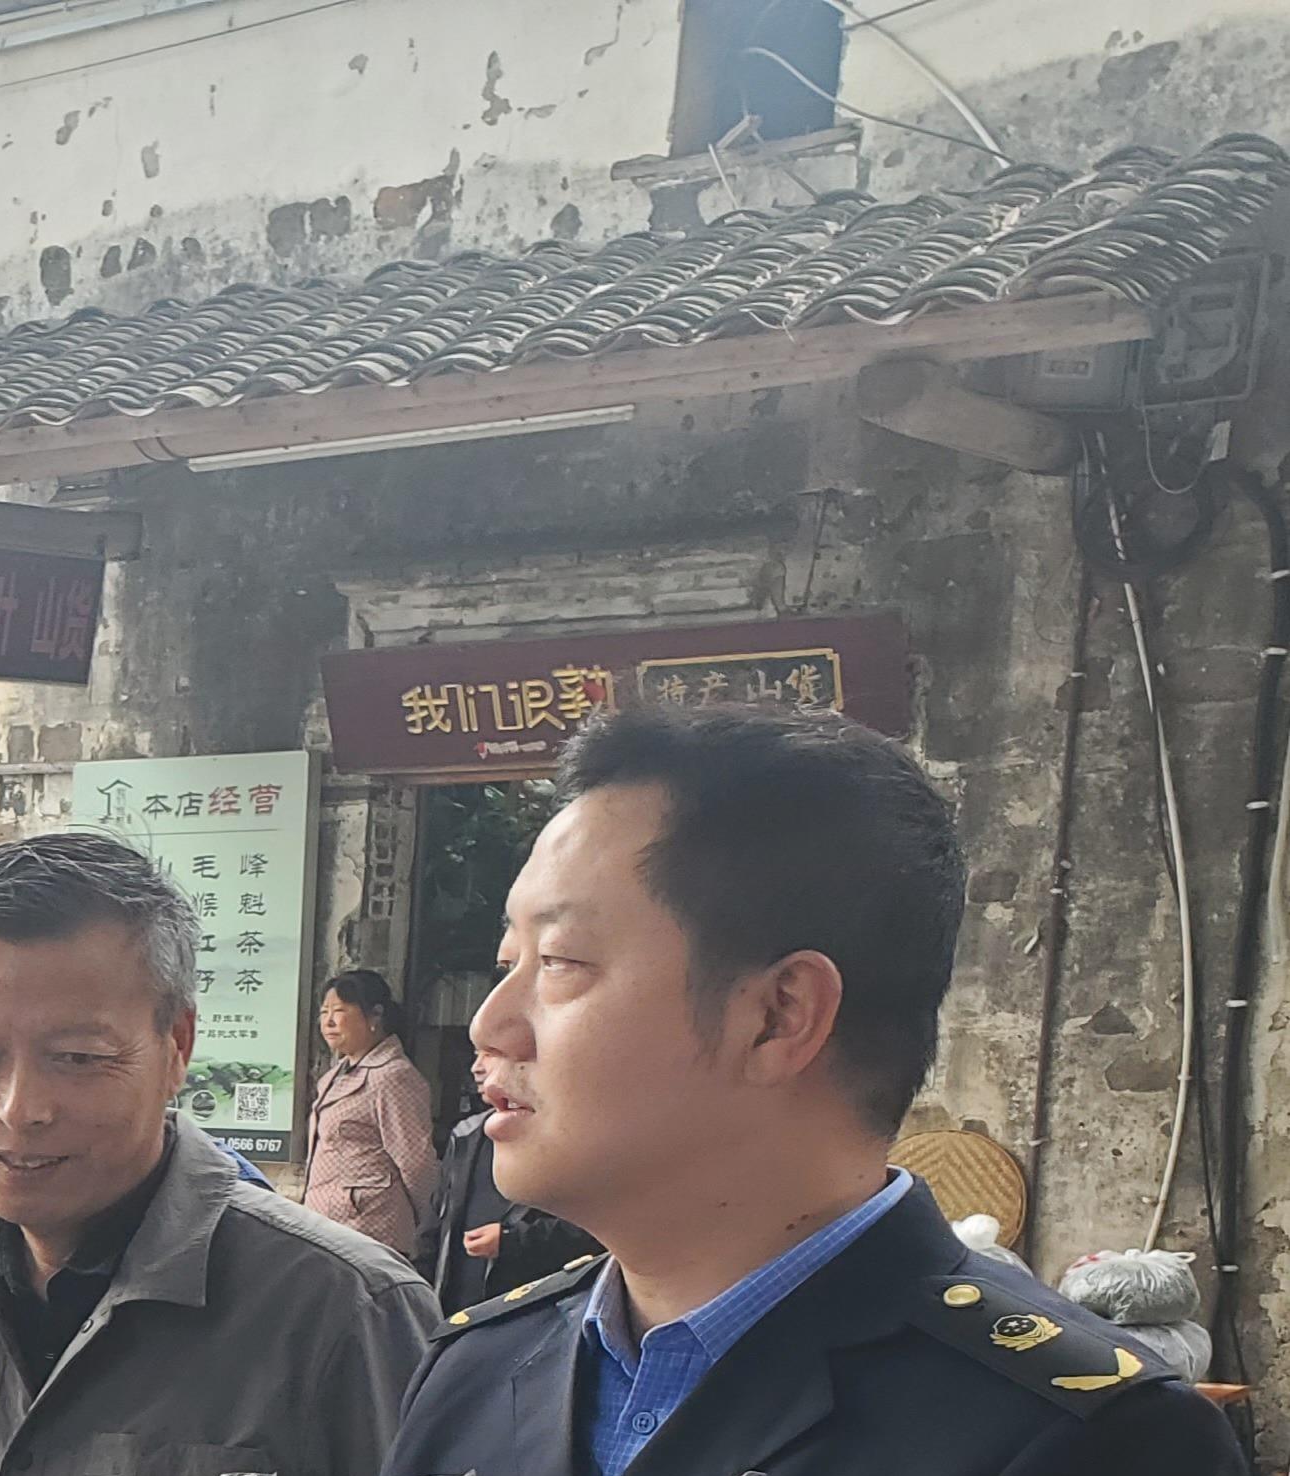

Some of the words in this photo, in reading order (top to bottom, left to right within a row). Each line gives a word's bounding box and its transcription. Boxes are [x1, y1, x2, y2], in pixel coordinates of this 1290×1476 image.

[142, 784, 283, 820] 本店经营
[256, 1139, 282, 1152] 6767
